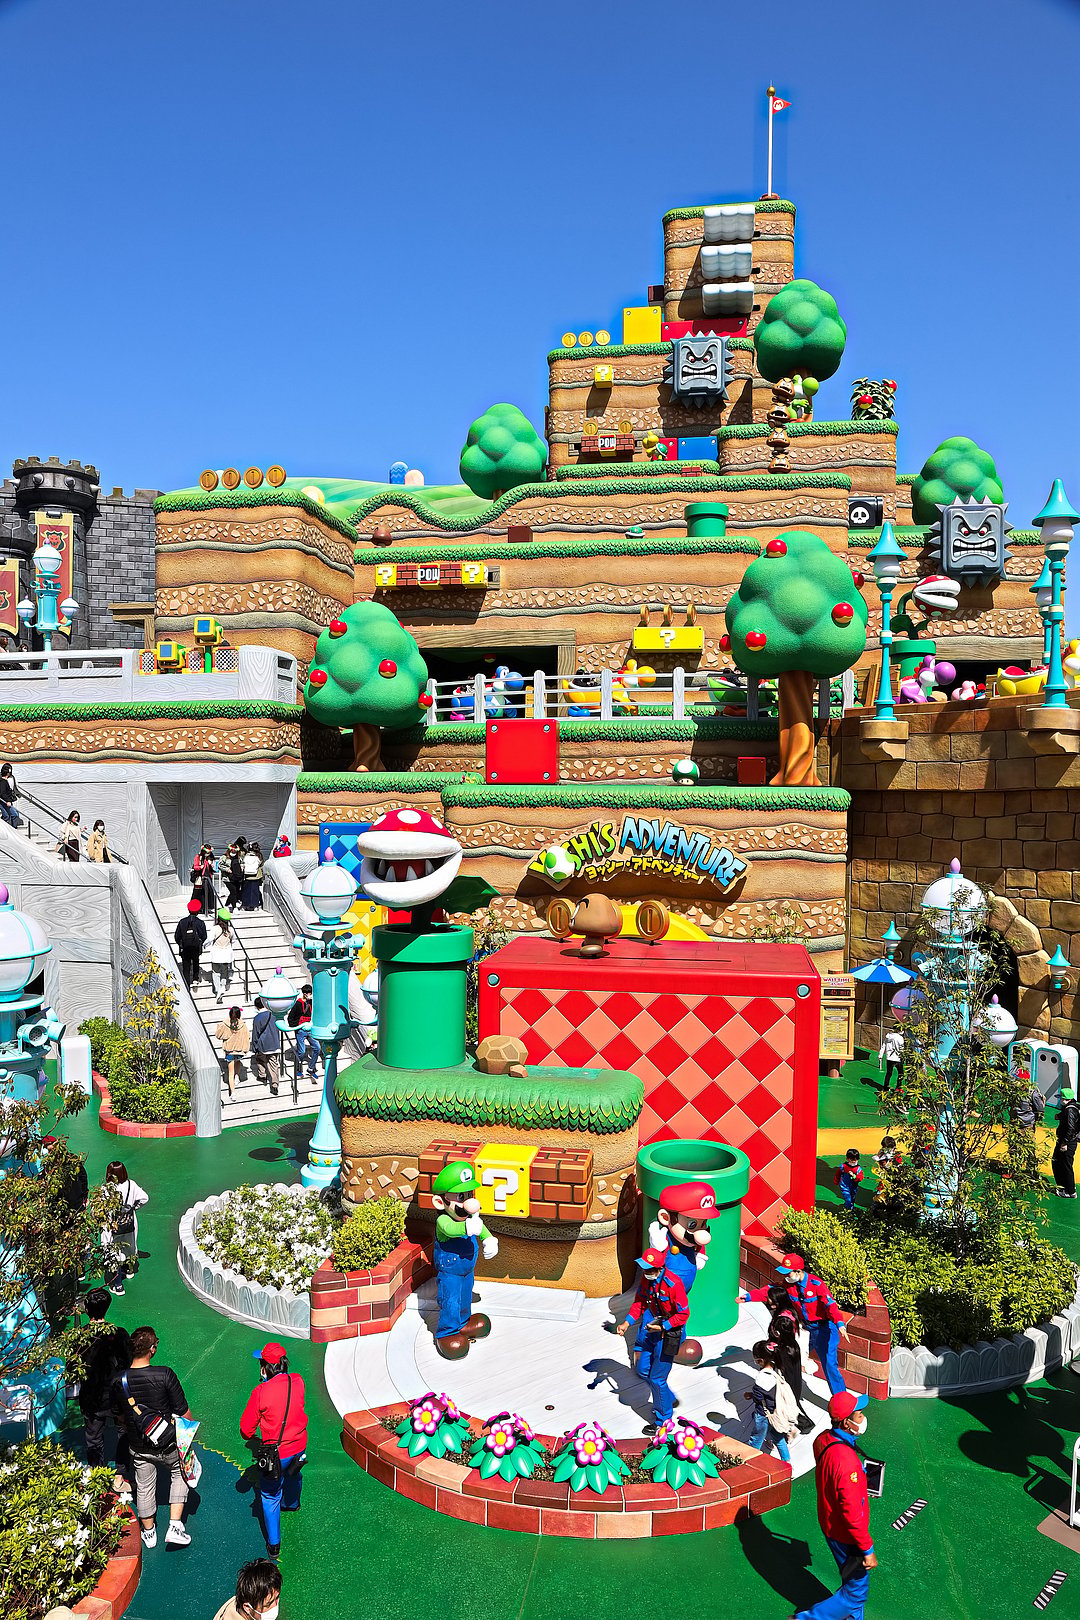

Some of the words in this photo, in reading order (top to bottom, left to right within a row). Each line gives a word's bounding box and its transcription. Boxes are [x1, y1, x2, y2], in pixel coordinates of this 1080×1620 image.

[597, 366, 609, 380] ?
[598, 437, 616, 448] POW
[377, 566, 393, 584] ?
[417, 568, 441, 581] POW
[464, 564, 480, 582] ?
[660, 629, 676, 648] ?
[620, 815, 747, 887] ADVENTURE
[481, 1167, 519, 1211] ?
